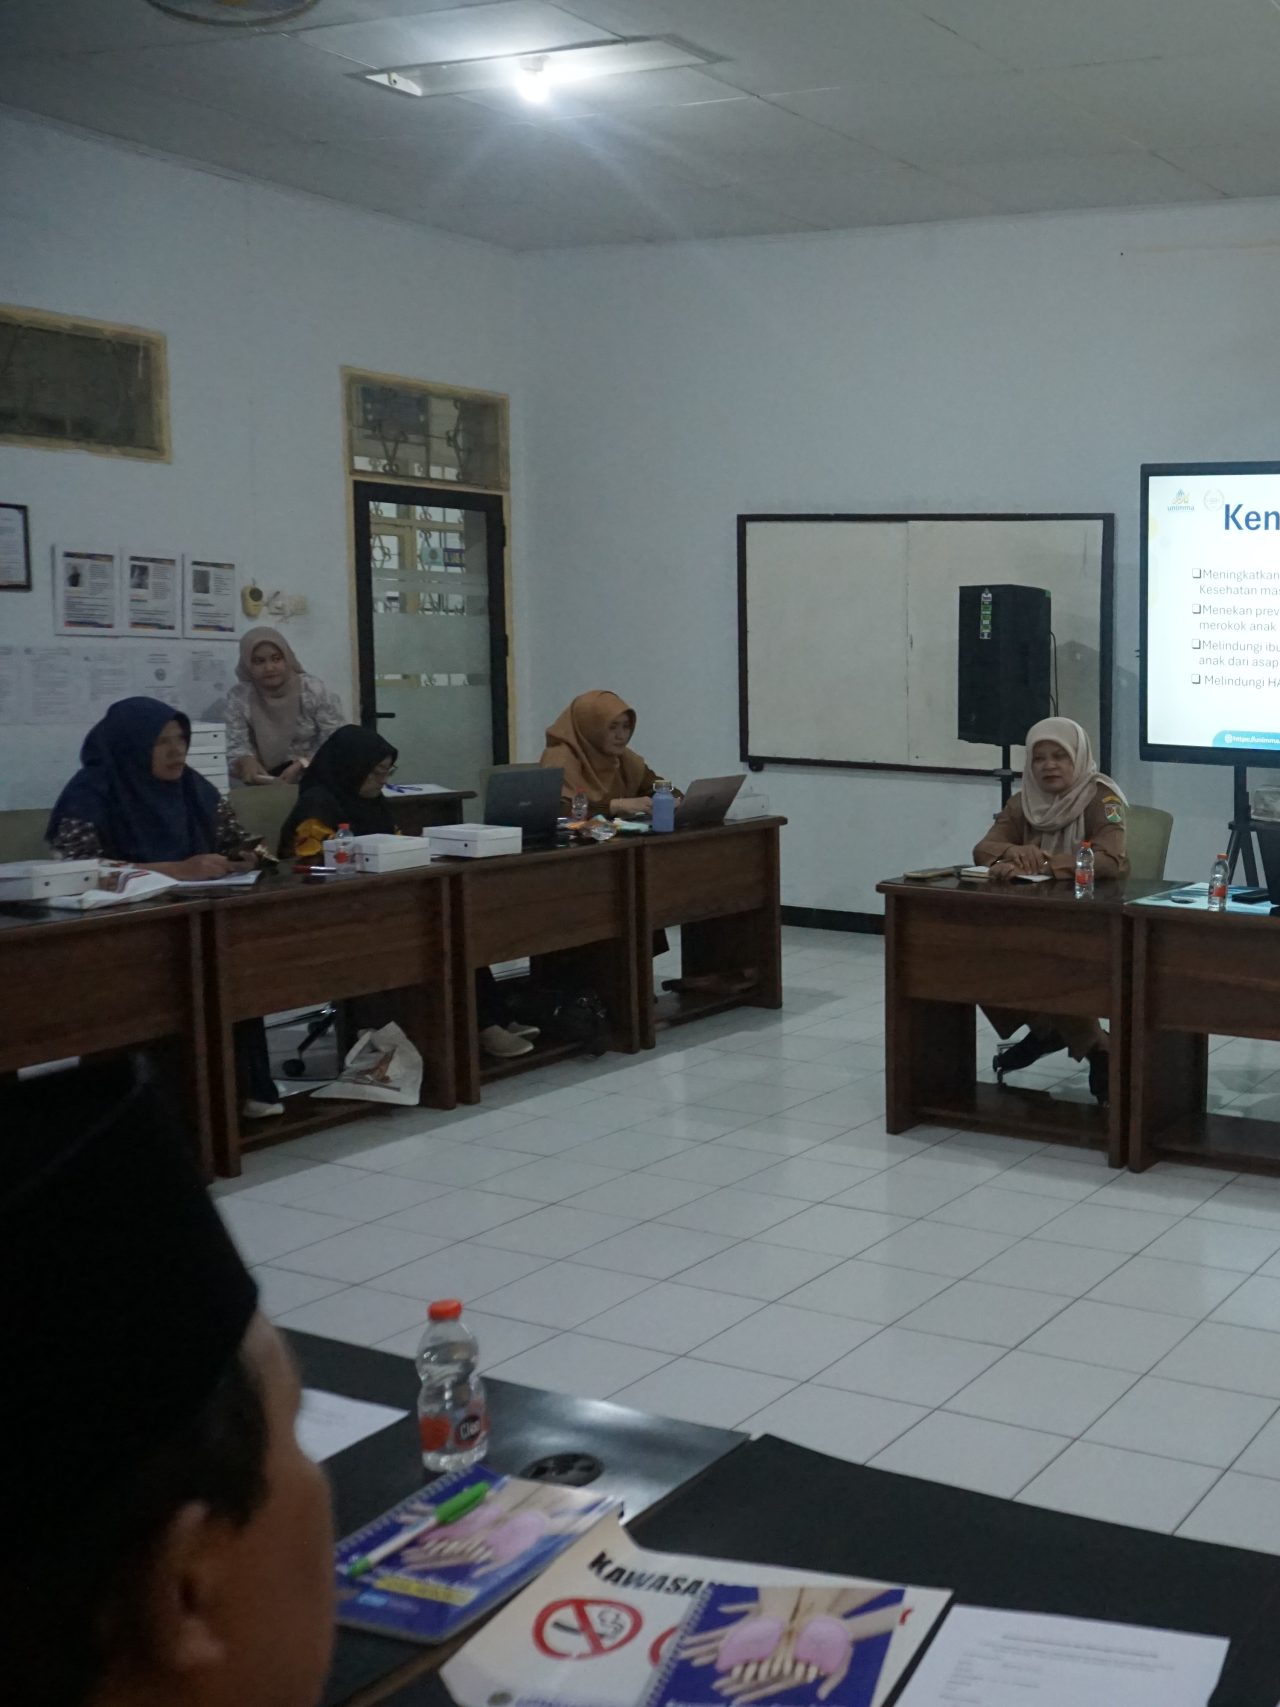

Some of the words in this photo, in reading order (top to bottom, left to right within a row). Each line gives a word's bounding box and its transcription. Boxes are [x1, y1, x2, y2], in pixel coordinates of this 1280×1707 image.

[1202, 569, 1280, 582] Meningkatkan
[1200, 584, 1258, 595] Kesehatan
[1202, 604, 1253, 615] Menekan
[1200, 620, 1247, 631] merokok
[1249, 621, 1277, 632] anak
[1202, 640, 1263, 654] Melindungi
[1199, 655, 1225, 666] anak
[1228, 656, 1249, 667] dari
[1251, 658, 1279, 669] asap
[1204, 675, 1265, 690] Melindungi
[588, 1550, 713, 1595] KAWASA
